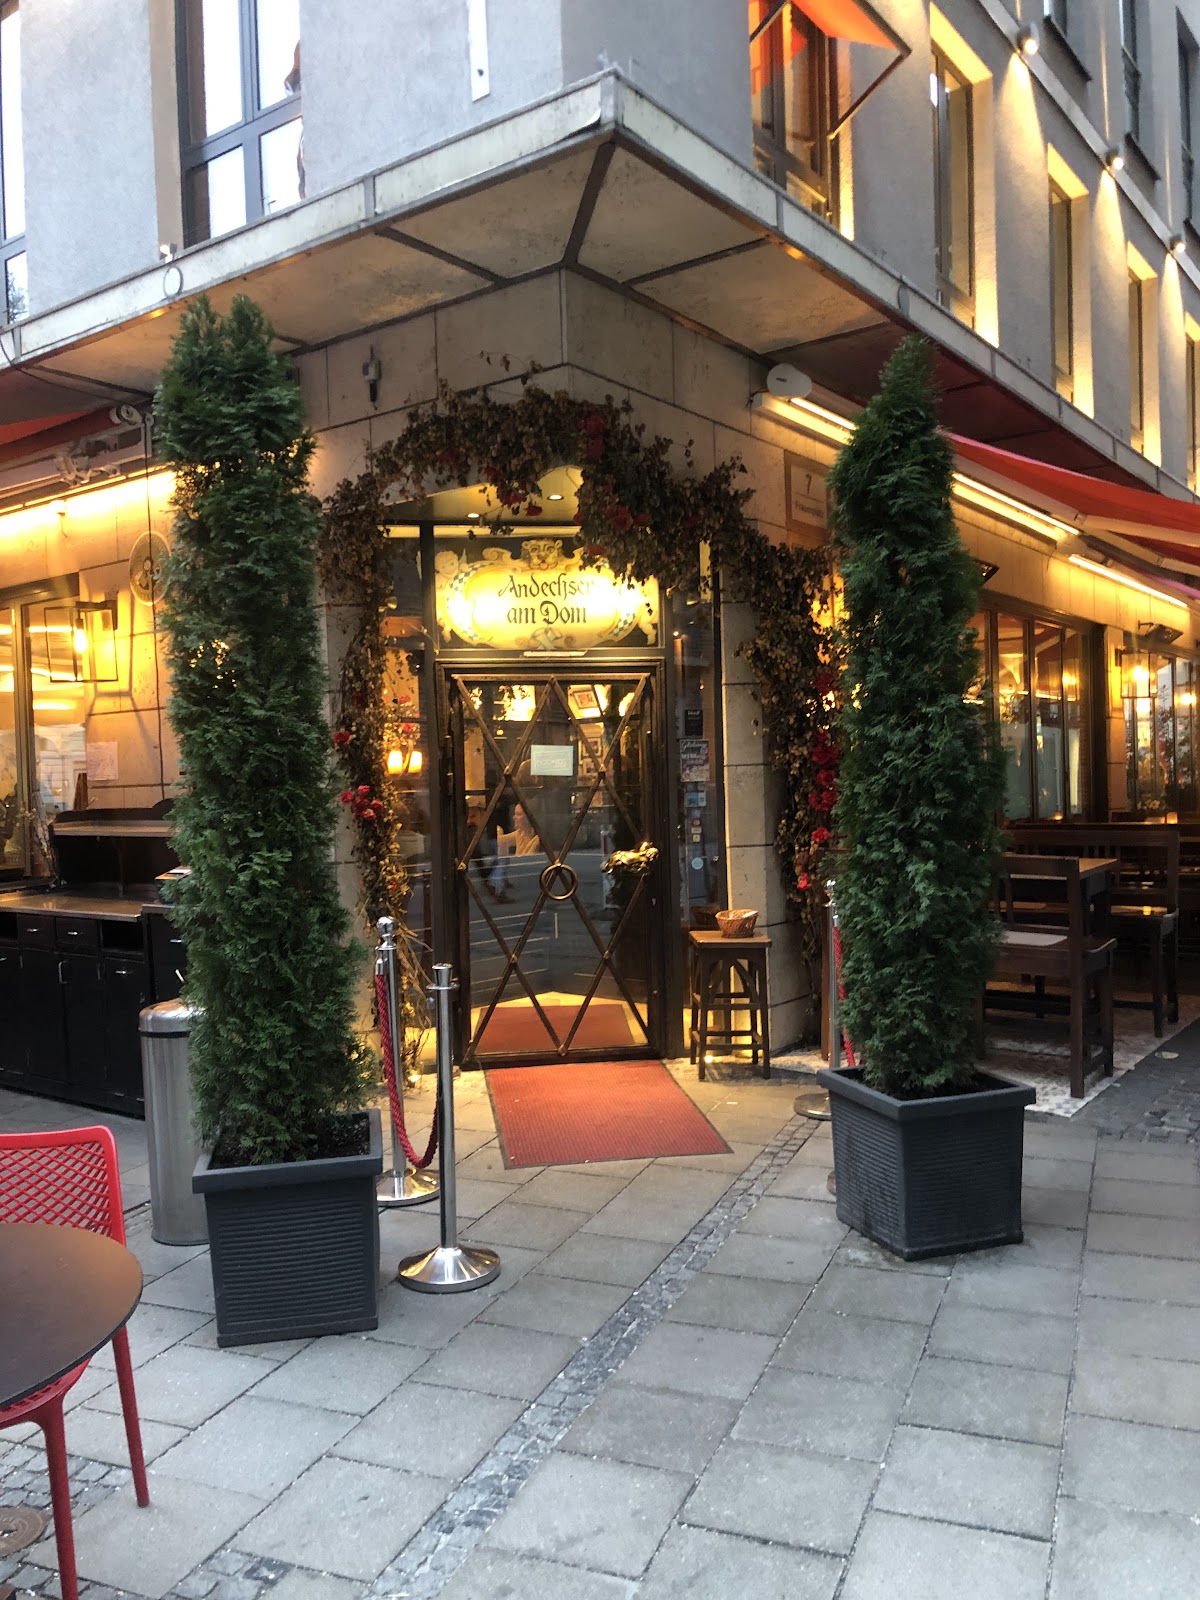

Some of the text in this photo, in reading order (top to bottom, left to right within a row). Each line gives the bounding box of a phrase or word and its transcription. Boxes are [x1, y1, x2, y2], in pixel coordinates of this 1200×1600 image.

[805, 473, 813, 495] 7
[498, 572, 595, 601] Andechser
[507, 600, 587, 625] am Dom
